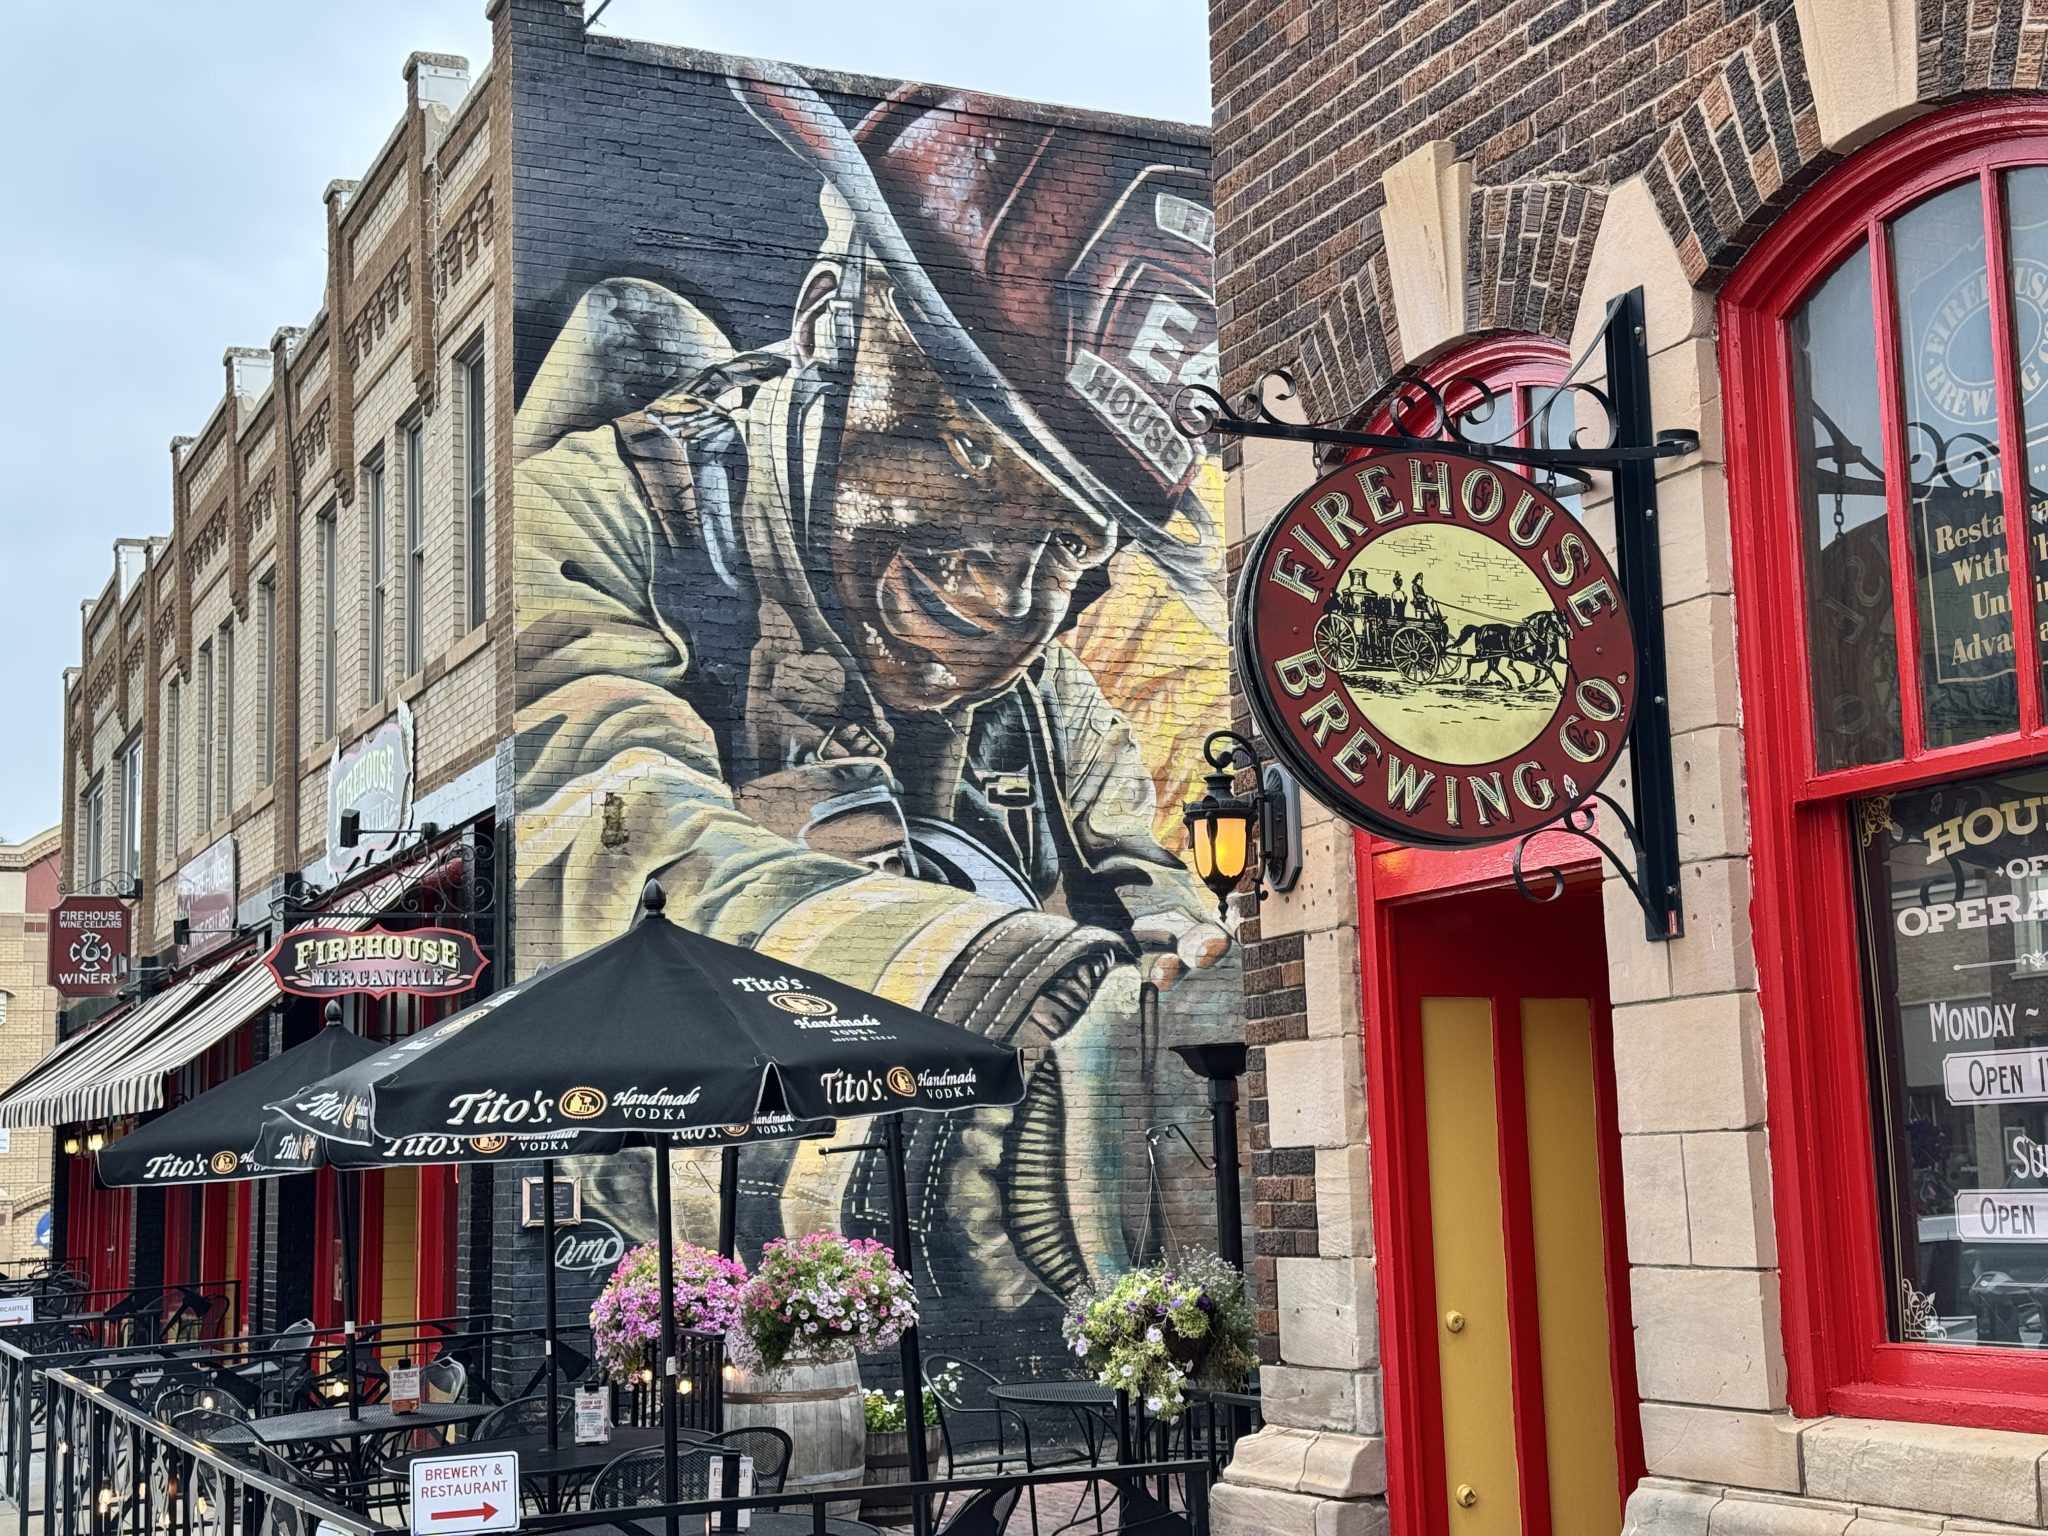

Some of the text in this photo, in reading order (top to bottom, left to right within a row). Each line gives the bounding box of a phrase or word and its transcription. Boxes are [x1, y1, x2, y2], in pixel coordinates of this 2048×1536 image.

[1924, 362, 2041, 416] BREWG
[1083, 366, 1183, 470] HOUSE
[1269, 458, 1618, 628] FIREHOUSE
[1274, 647, 1555, 828] BREWING
[336, 744, 394, 832] FIREHOUSE
[1923, 796, 2048, 865] HOU
[2005, 855, 2048, 879] OF
[60, 910, 122, 920] FIREHOUSE
[60, 920, 122, 928] WINE CELLARS
[295, 935, 460, 973] FIREHOUSE
[59, 972, 119, 984] WINERY
[311, 968, 445, 987] MERCANTILE
[793, 1014, 881, 1029] Handmade
[1929, 1002, 2016, 1042] MONDAY
[830, 1028, 877, 1036] VODKA
[917, 1067, 976, 1087] Handmade
[1968, 1060, 2024, 1096] OPEN
[612, 1086, 701, 1107] Handmade
[926, 1086, 975, 1099] VODKA
[623, 1108, 686, 1120] VODKA
[757, 1124, 794, 1135] VODKA
[520, 1141, 569, 1151] VODKA
[2012, 1136, 2048, 1179] SU
[1980, 1197, 2036, 1235] OPEN
[425, 1463, 504, 1482] BREWERY &
[421, 1480, 508, 1499] RESTAURANT
